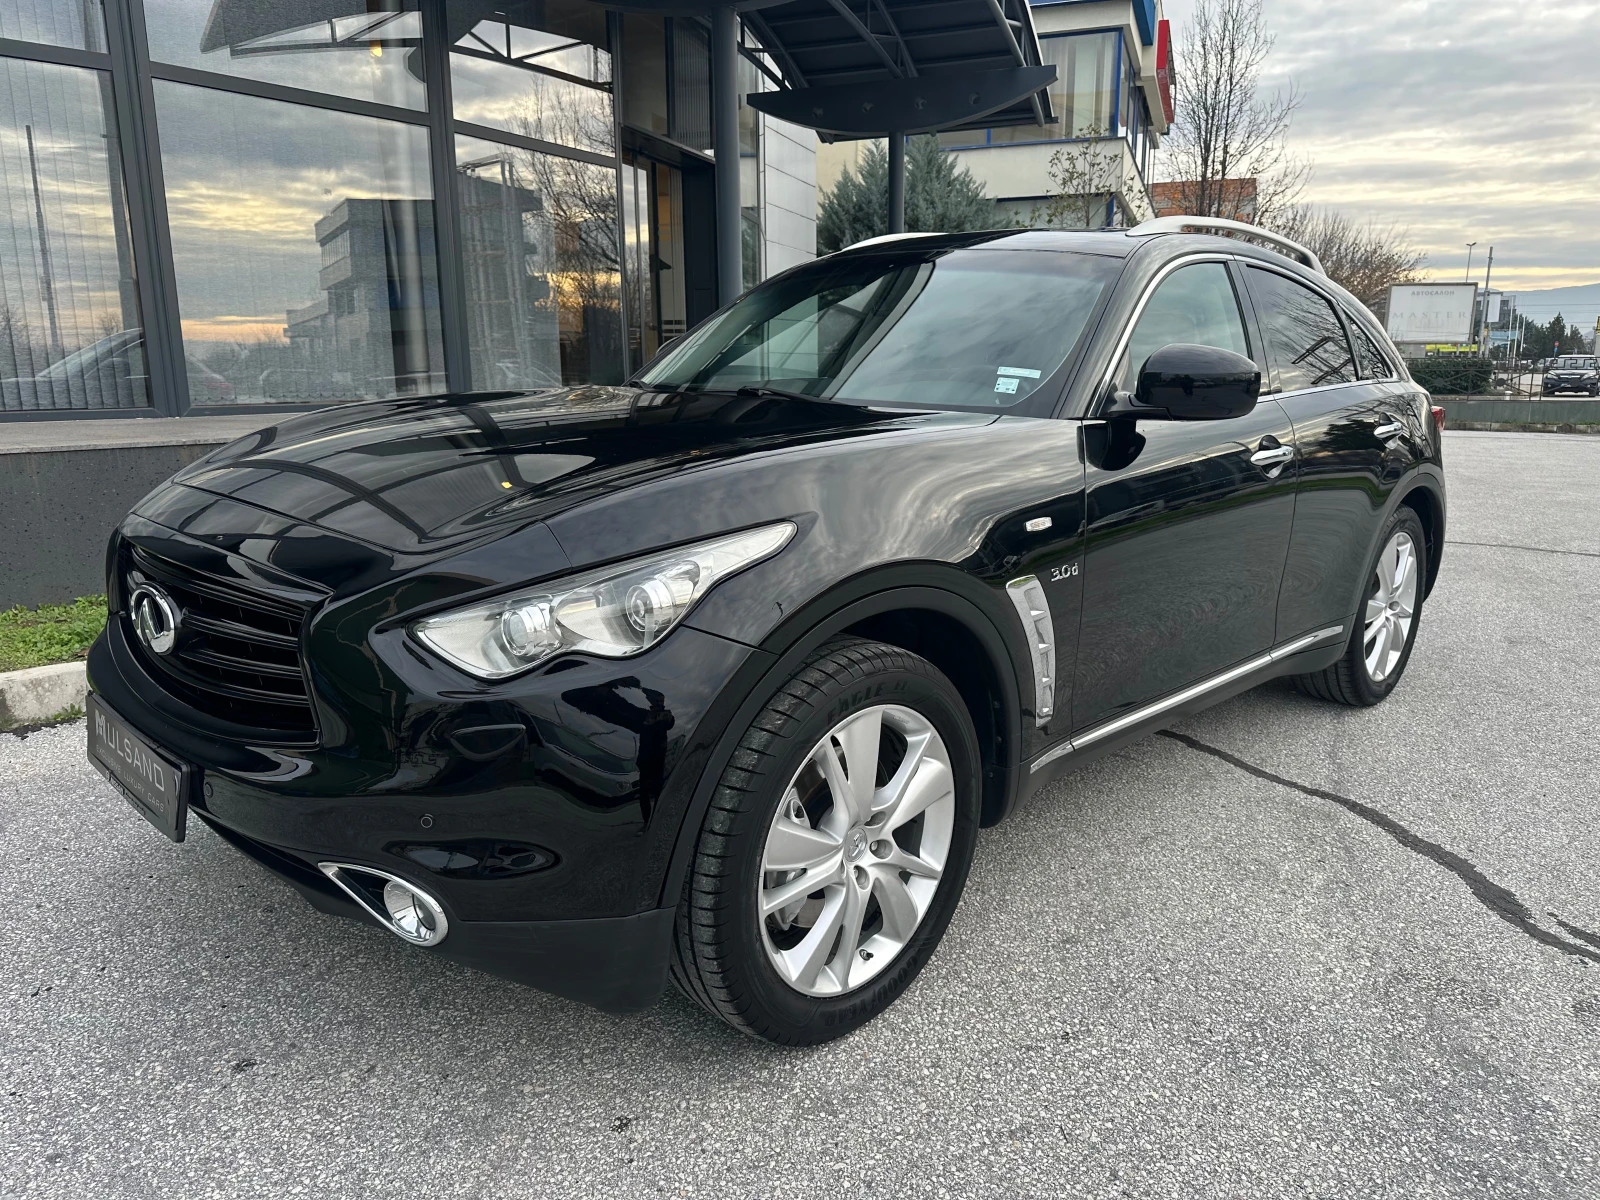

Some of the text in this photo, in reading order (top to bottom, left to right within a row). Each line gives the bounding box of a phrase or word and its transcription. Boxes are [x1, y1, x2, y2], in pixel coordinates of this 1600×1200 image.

[1410, 289, 1455, 297] АВТОСАЛОН
[1392, 311, 1468, 319] MASTER
[826, 681, 886, 726] EAGLE
[123, 771, 145, 795] LUXURY
[147, 792, 165, 813] CARS
